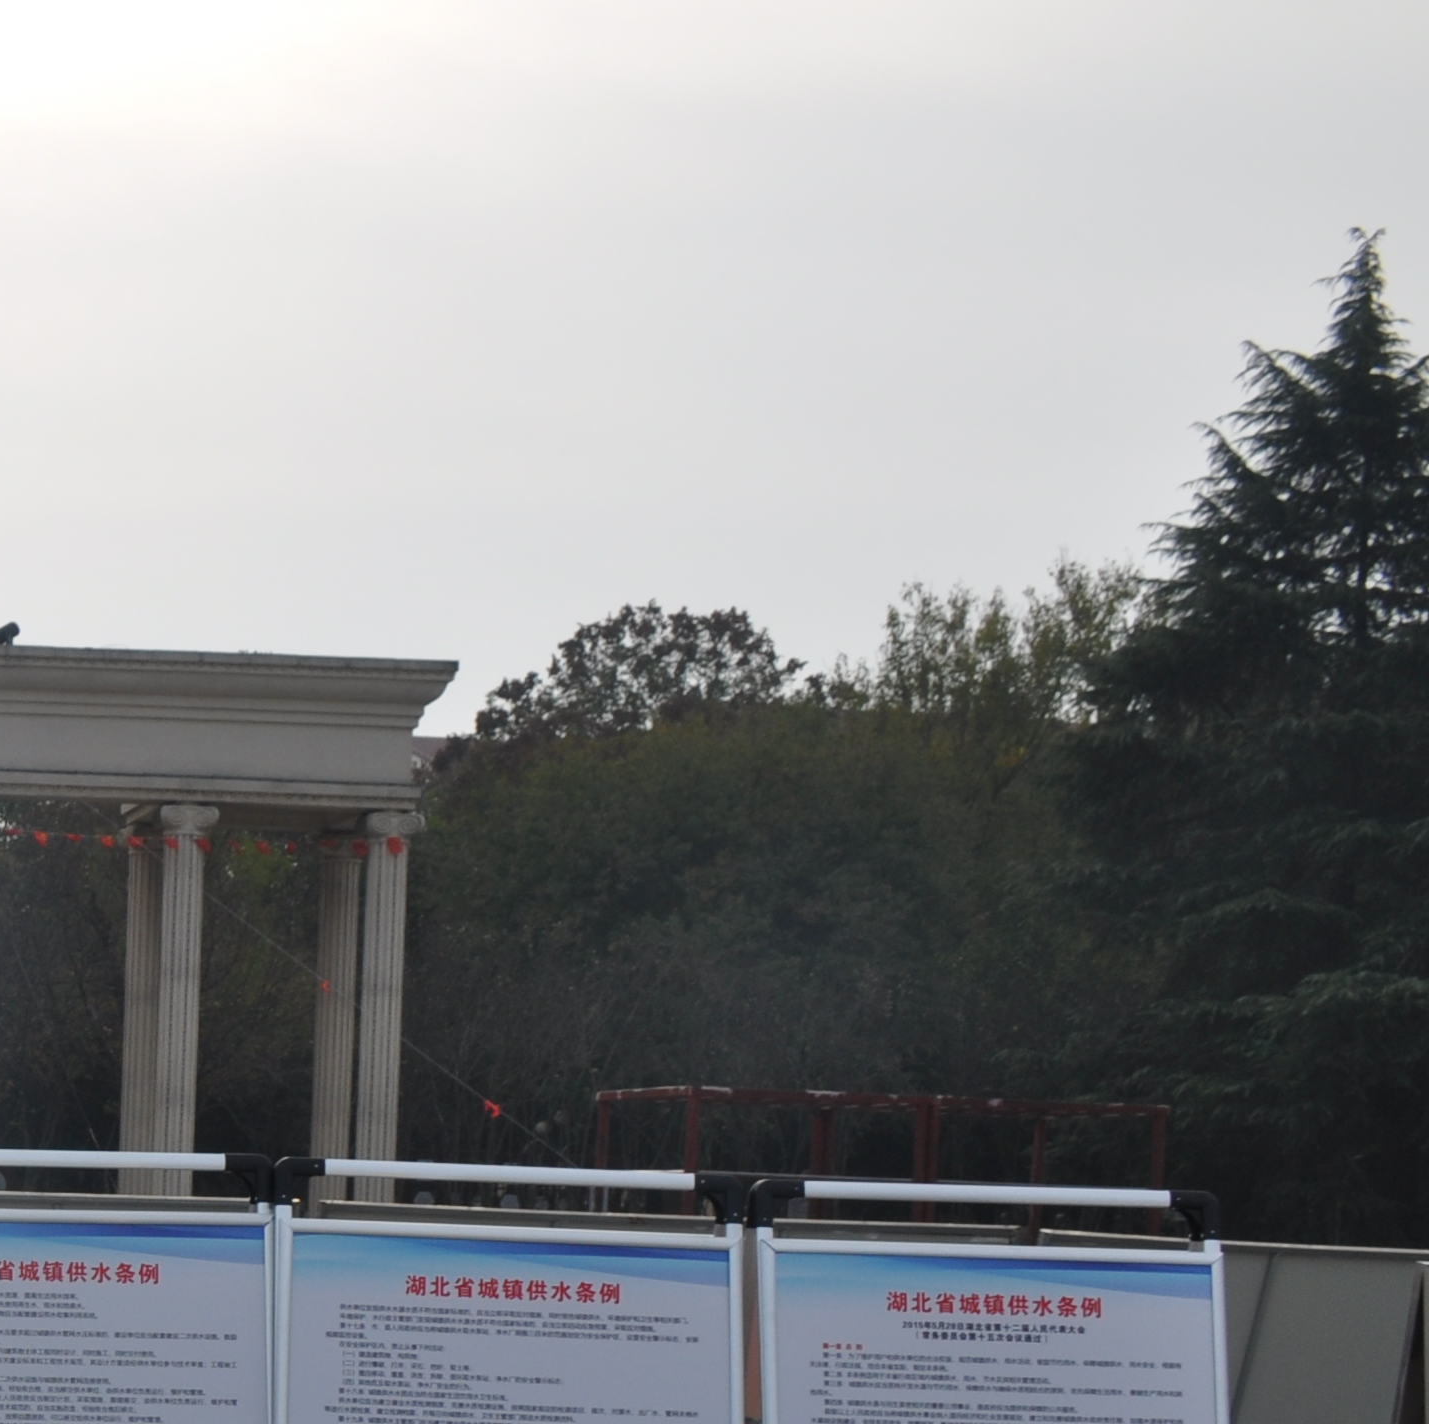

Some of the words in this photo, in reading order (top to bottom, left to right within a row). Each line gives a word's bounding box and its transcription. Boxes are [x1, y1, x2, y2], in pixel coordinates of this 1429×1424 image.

[405, 1274, 621, 1304] 湖北省城镇供水条例
[886, 1291, 1103, 1319] 湖北省城镇供水条例
